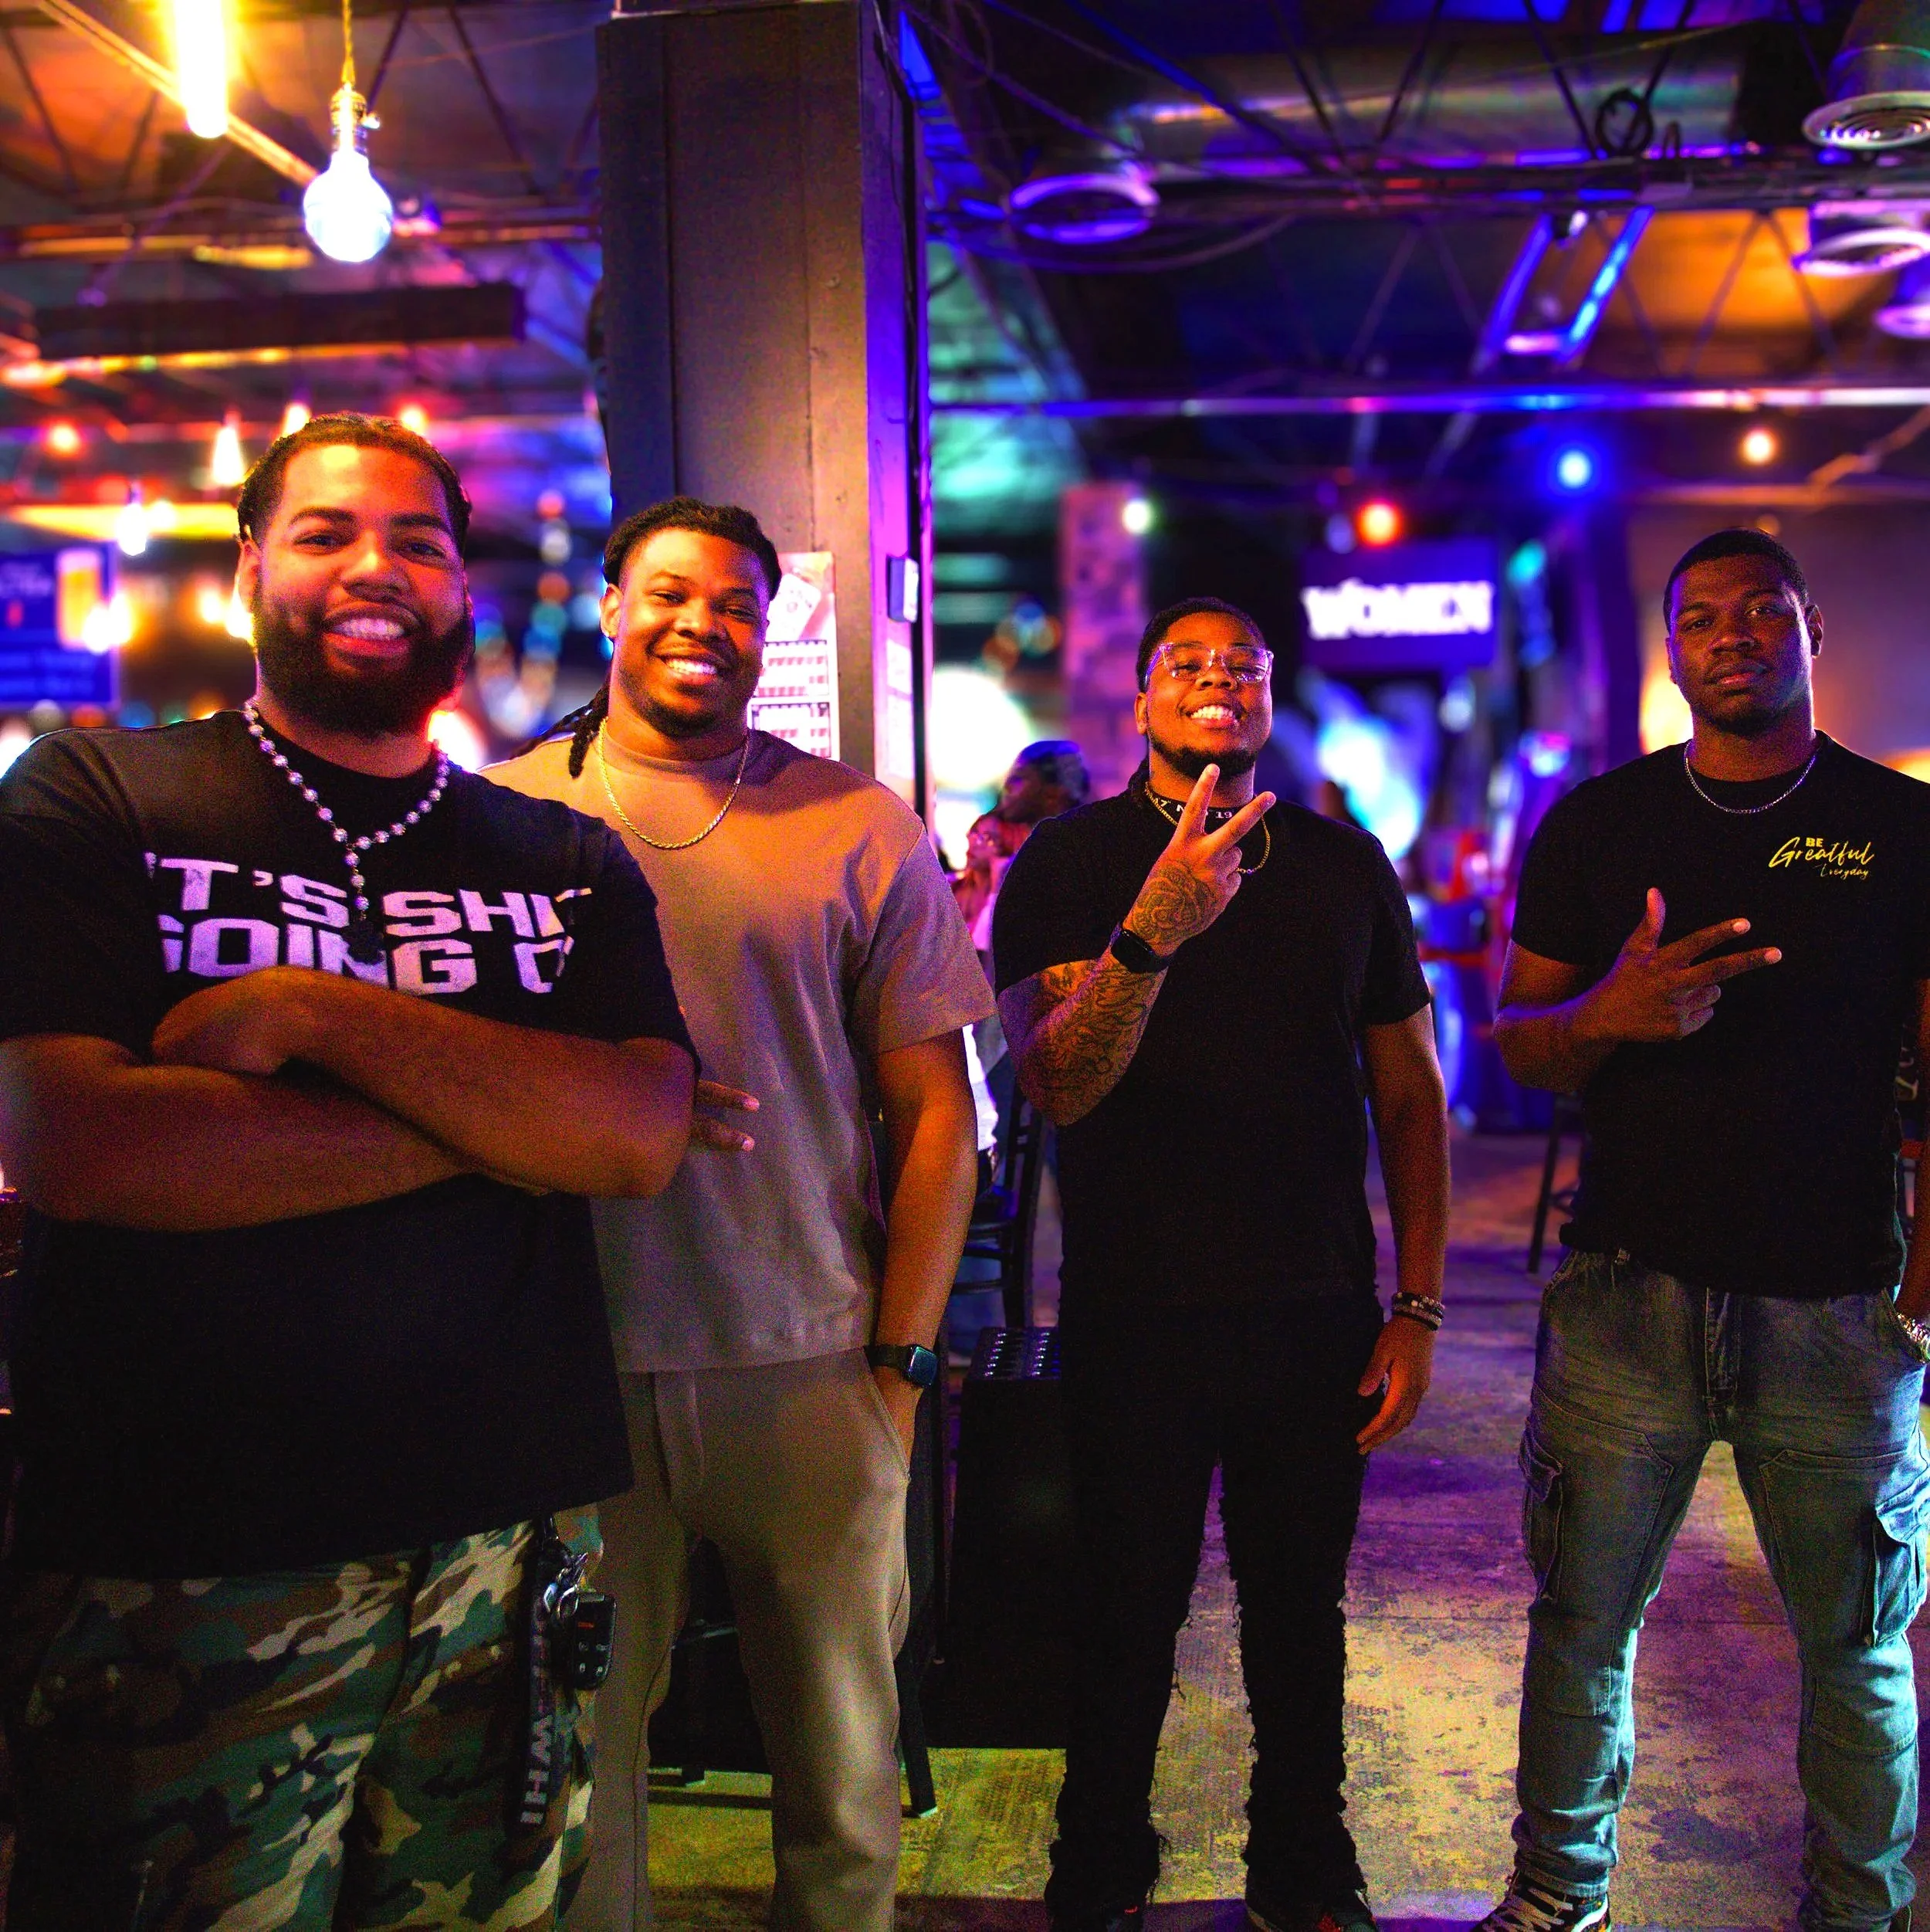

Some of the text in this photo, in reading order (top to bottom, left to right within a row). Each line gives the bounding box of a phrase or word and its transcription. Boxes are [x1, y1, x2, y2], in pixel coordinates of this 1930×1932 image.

[1806, 837, 1823, 848] BE
[144, 852, 593, 937] T'S SHI
